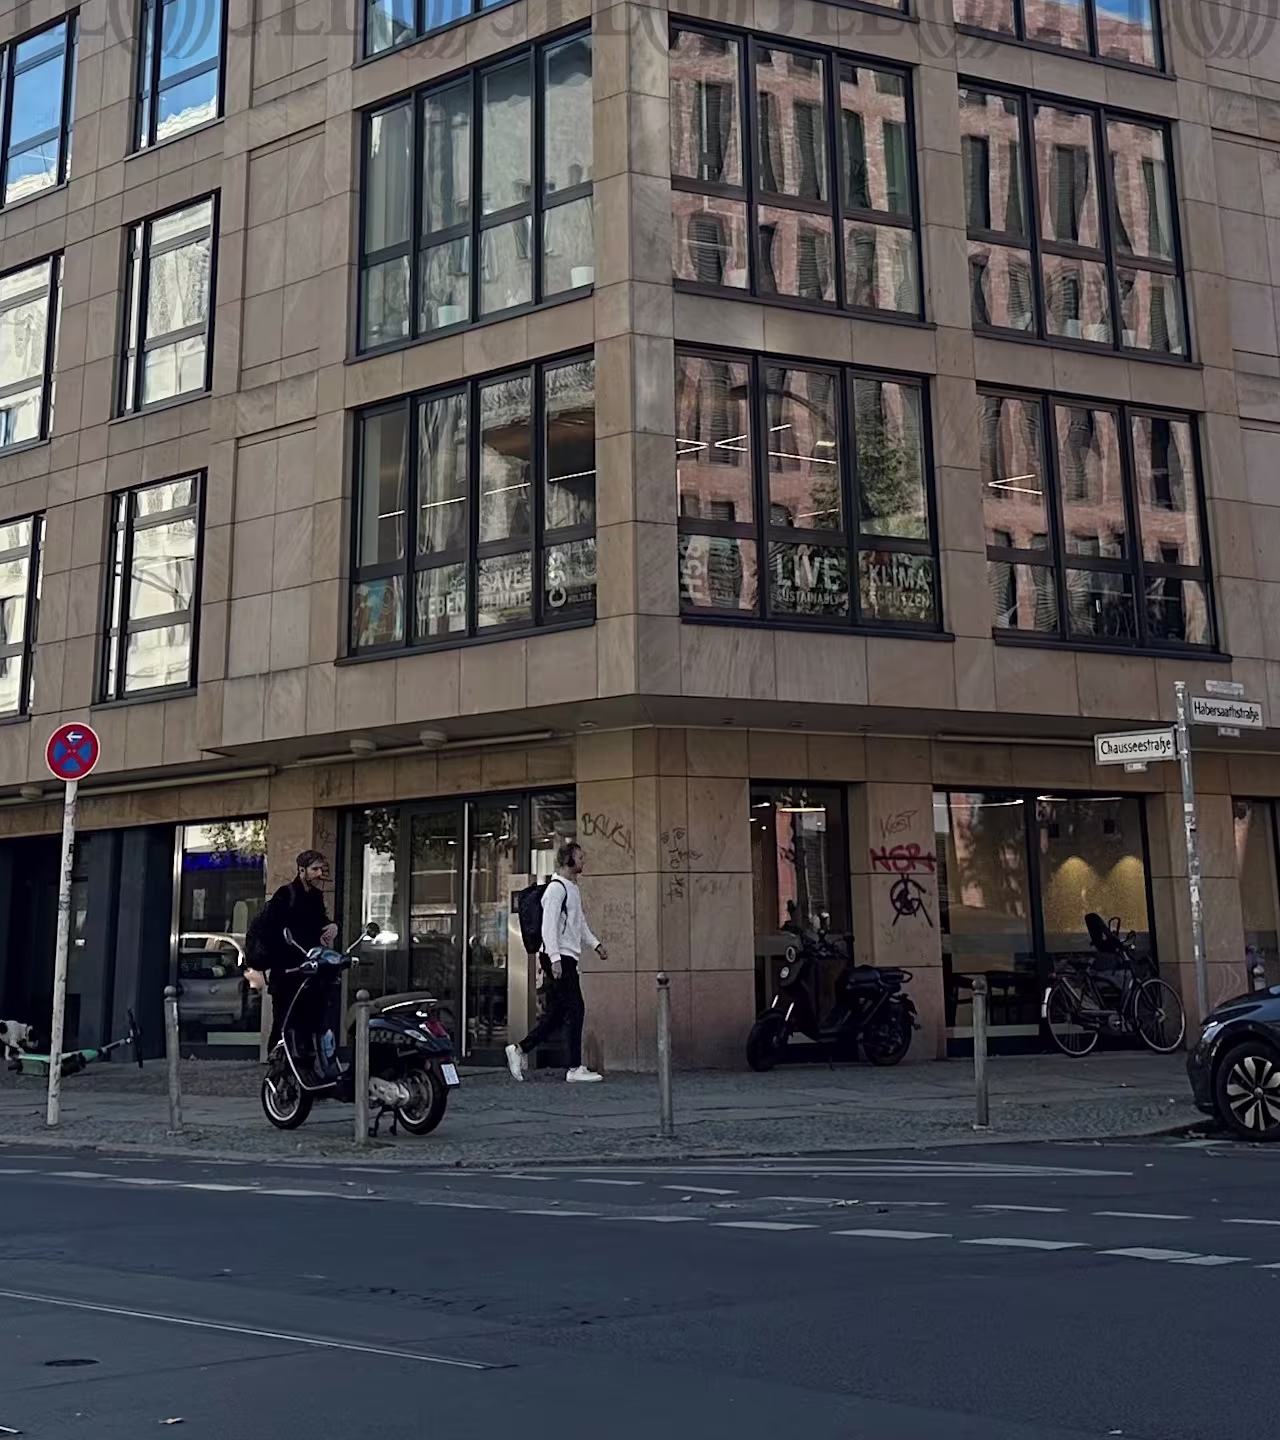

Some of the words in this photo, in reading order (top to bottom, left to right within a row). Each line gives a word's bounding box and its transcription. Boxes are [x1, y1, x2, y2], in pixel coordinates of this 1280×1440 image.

[776, 554, 841, 590] LIVE
[869, 563, 930, 593] KLIMA
[1100, 735, 1171, 755] Chausseestraße
